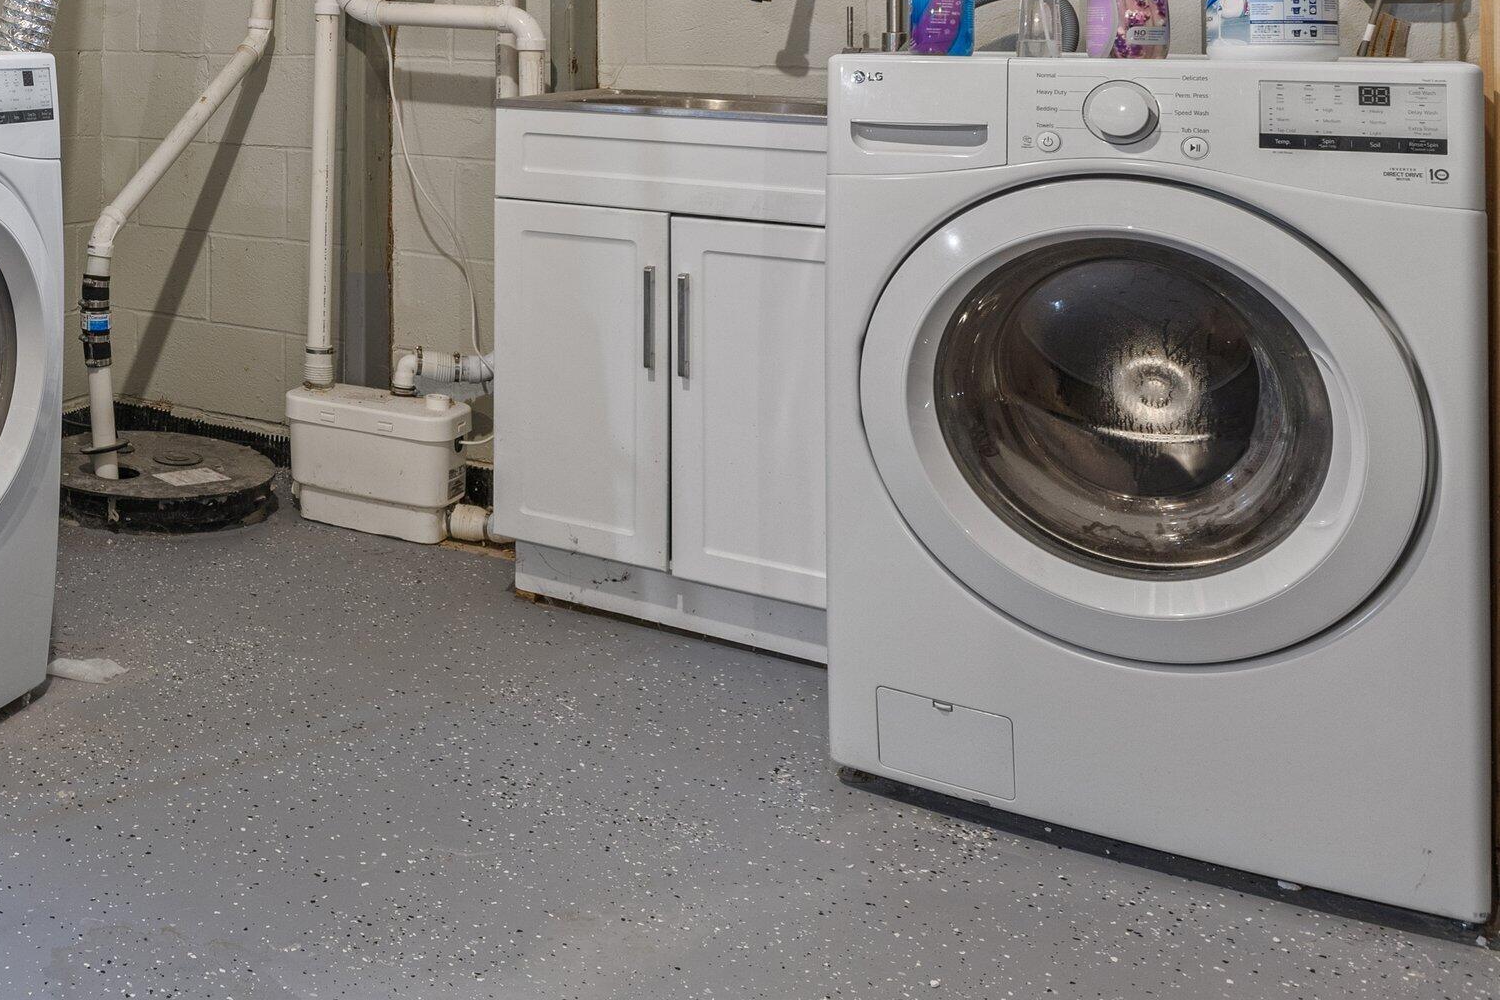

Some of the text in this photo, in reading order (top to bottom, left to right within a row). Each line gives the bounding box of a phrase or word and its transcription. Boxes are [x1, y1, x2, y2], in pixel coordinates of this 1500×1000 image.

[1036, 105, 1058, 113] Bedding
[1174, 109, 1191, 117] Speed
[1322, 138, 1336, 146] Spin
[1369, 141, 1382, 149] Soil
[1429, 168, 1450, 181] 10
